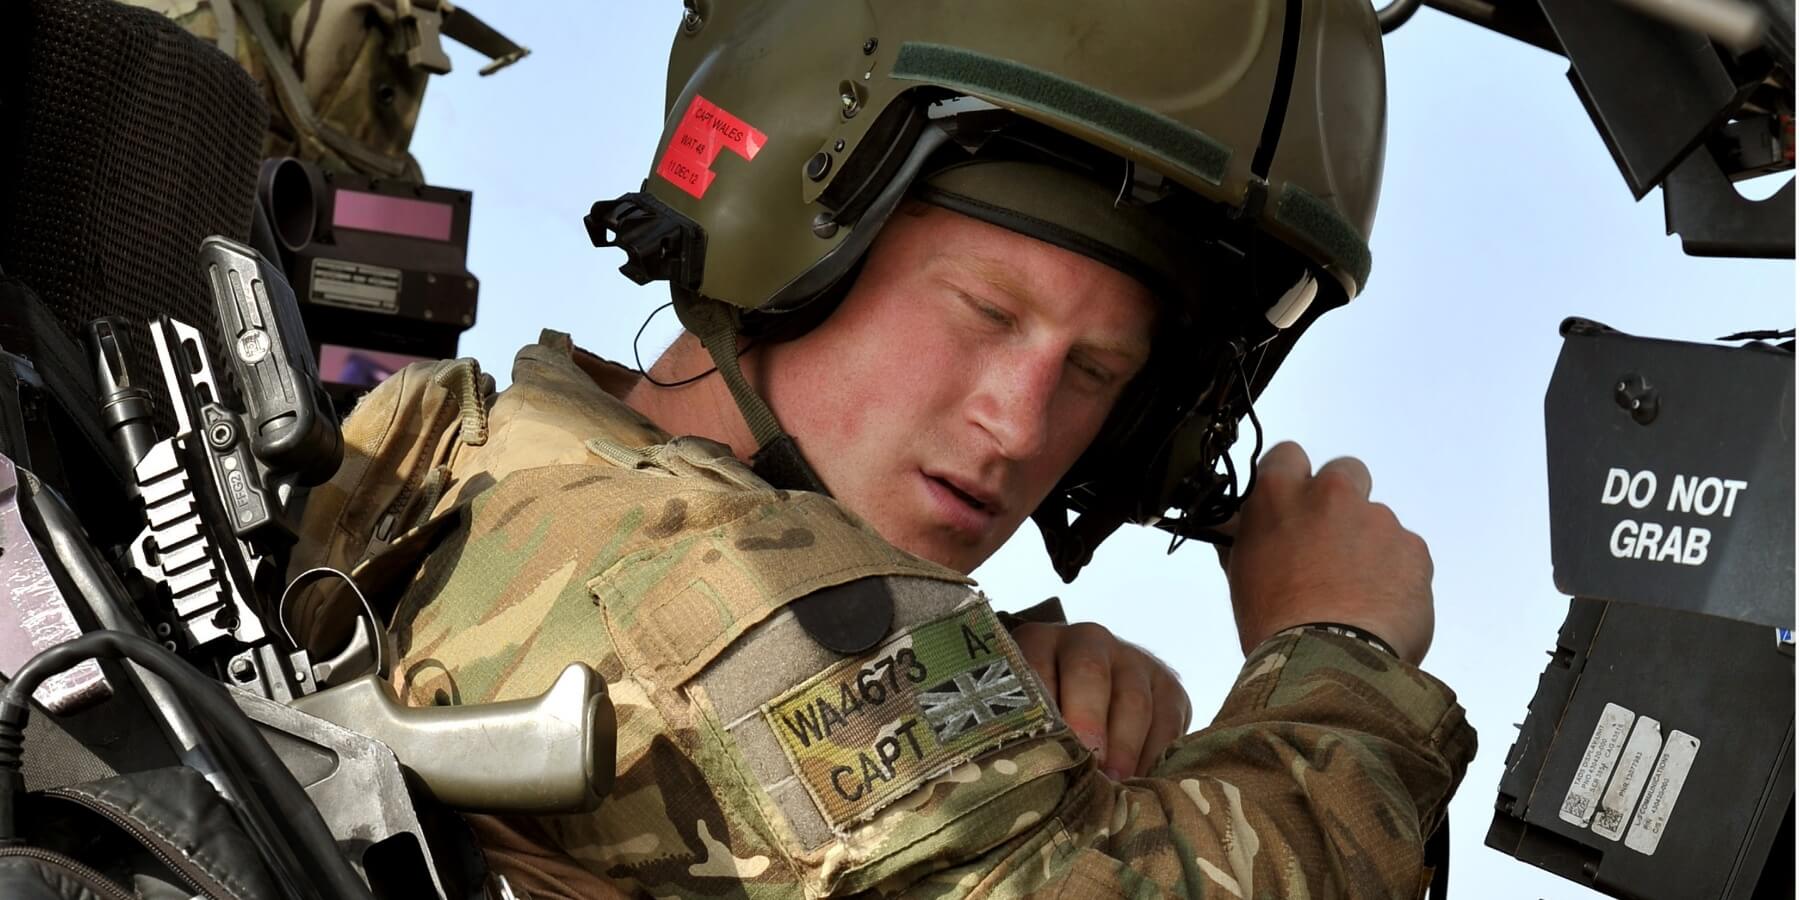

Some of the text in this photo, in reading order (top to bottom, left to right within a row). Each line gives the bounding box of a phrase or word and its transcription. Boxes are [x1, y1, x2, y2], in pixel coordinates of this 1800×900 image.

[681, 134, 697, 149] WAT
[695, 108, 743, 141] CAPT WALES
[674, 163, 690, 180] DEC
[688, 172, 699, 185] 12
[1601, 467, 1748, 517] DO NOT
[1609, 519, 1712, 566] GRAB
[783, 648, 928, 748] WA4673
[831, 719, 925, 802] CAPT
[1573, 768, 1585, 785] TADS
[1582, 740, 1598, 766] DISPLAY
[1640, 753, 1670, 813] COMMUNICATIONS
